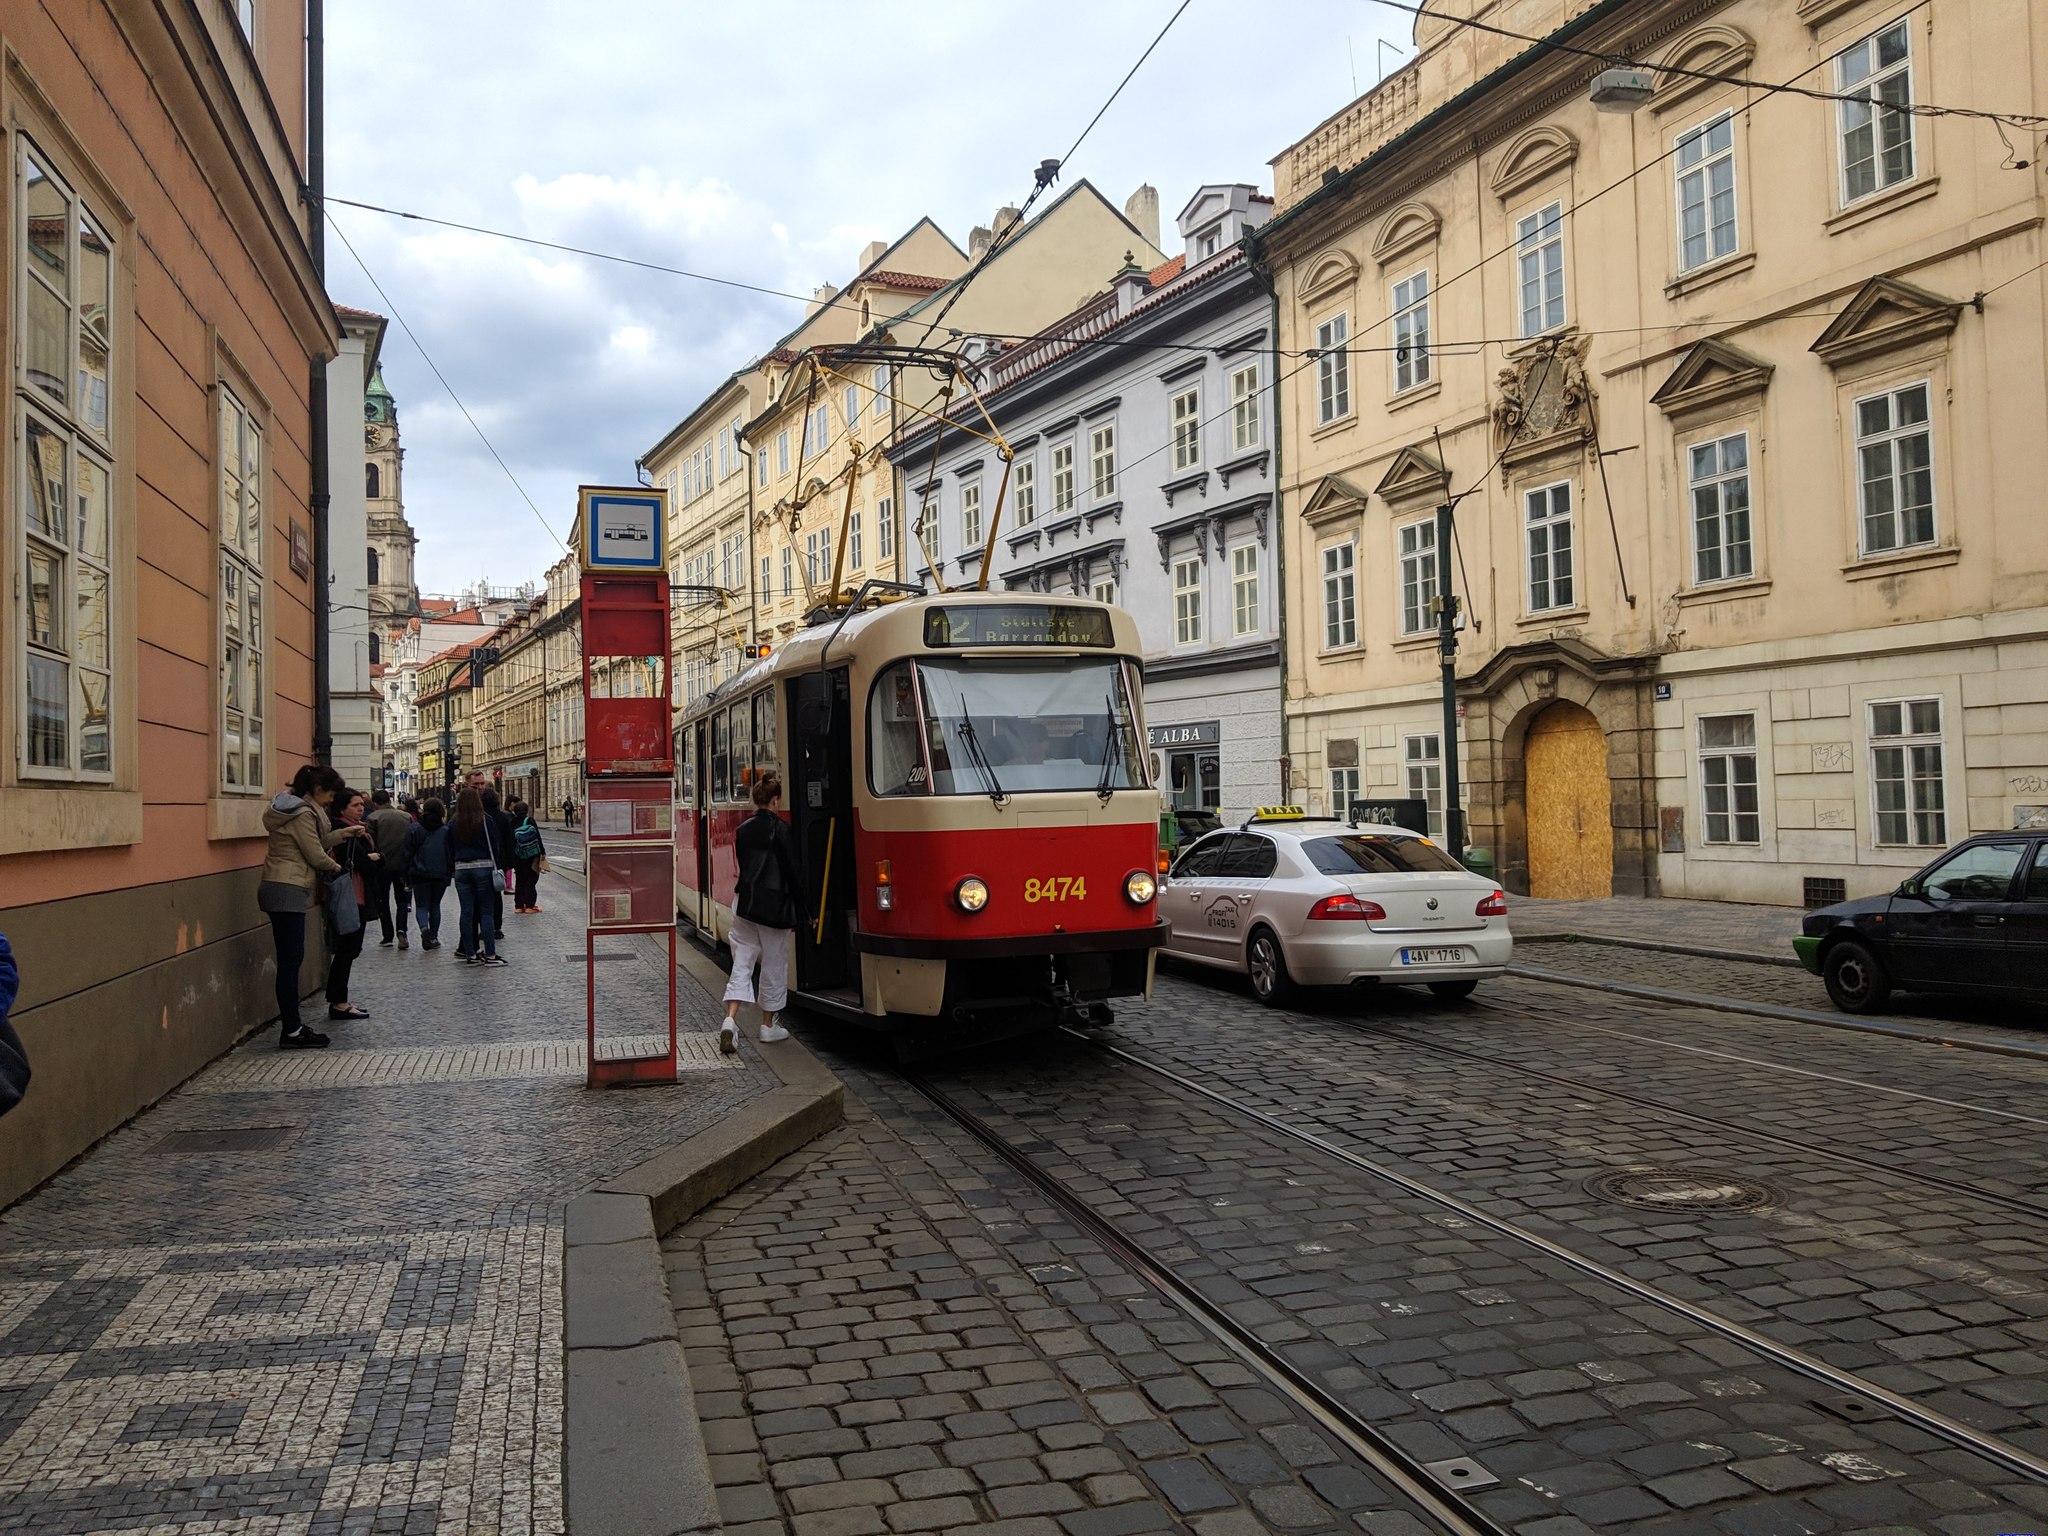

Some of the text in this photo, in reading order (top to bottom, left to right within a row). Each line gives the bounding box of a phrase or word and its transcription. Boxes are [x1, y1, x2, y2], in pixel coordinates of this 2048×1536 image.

[932, 613, 971, 644] 12
[985, 630, 1091, 644] Barrandov
[1657, 685, 1666, 694] 10
[1160, 727, 1201, 744] ALBA
[1266, 806, 1299, 814] TAXI
[1024, 876, 1087, 903] 8474
[1212, 917, 1236, 929] 14015
[1411, 950, 1429, 962] 4AV
[1437, 949, 1461, 961] 1716
